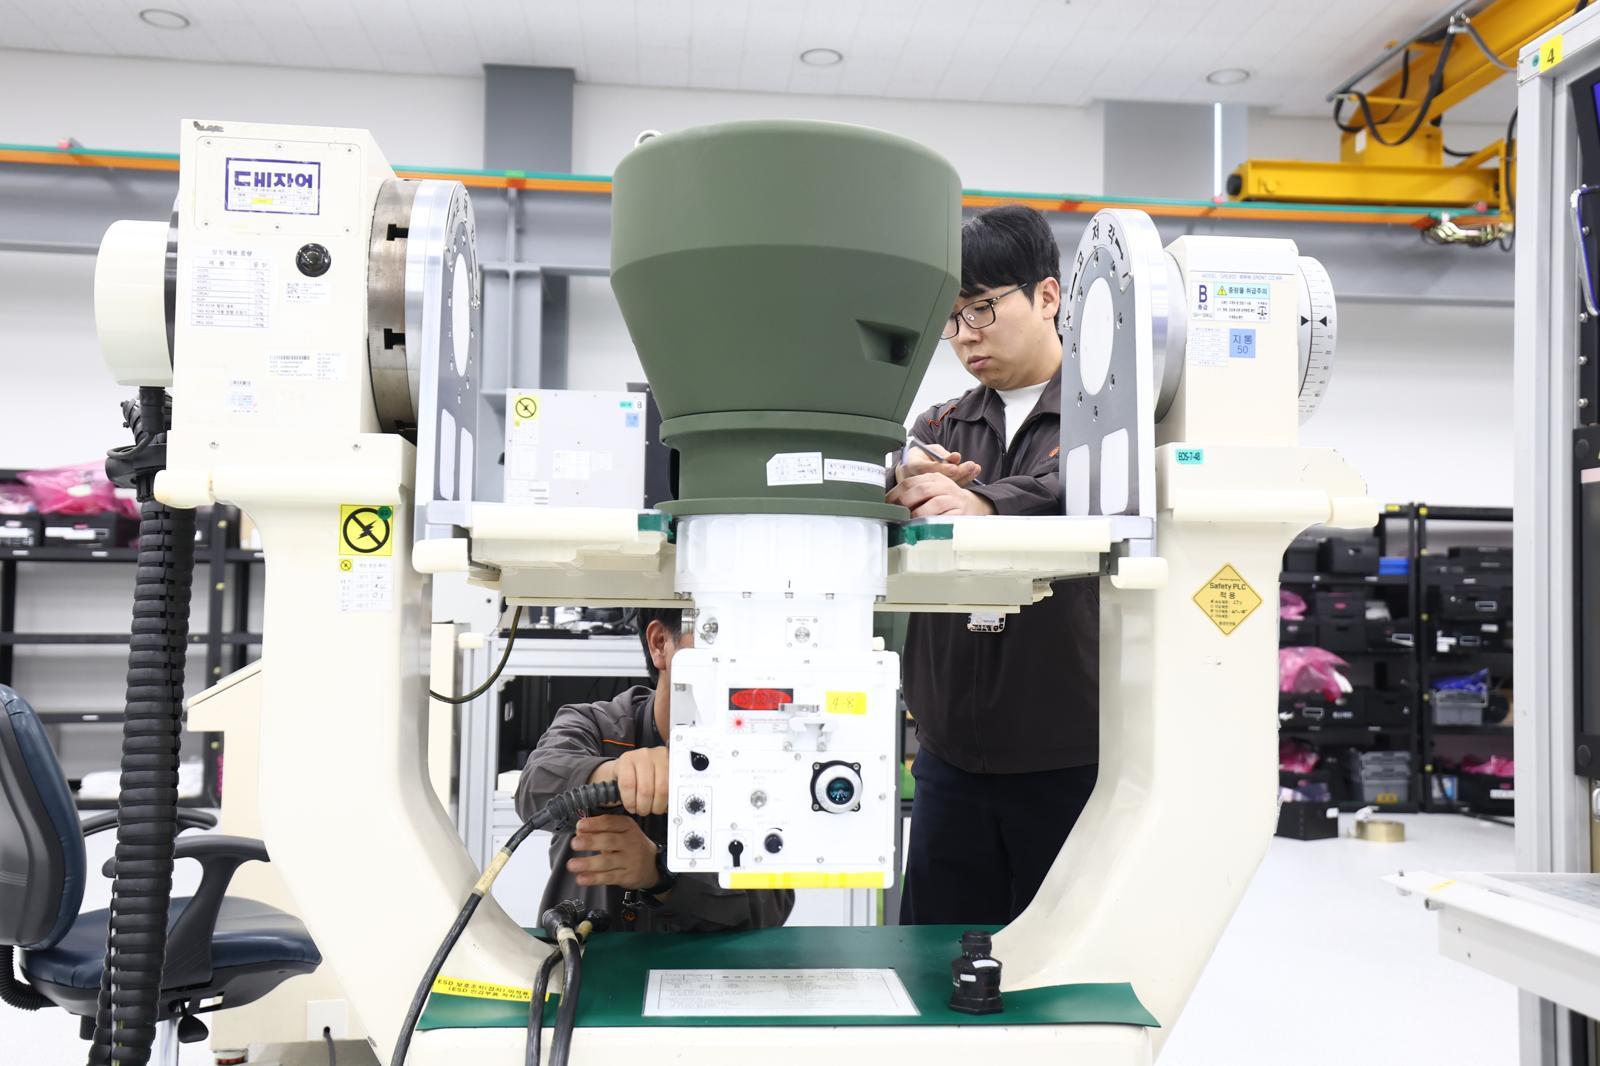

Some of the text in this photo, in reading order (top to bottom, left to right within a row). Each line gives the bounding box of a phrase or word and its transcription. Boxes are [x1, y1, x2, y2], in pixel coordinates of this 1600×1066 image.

[1546, 48, 1555, 64] 4
[1199, 284, 1208, 303] B
[1237, 345, 1249, 354] 50
[1209, 582, 1232, 591] Safety
